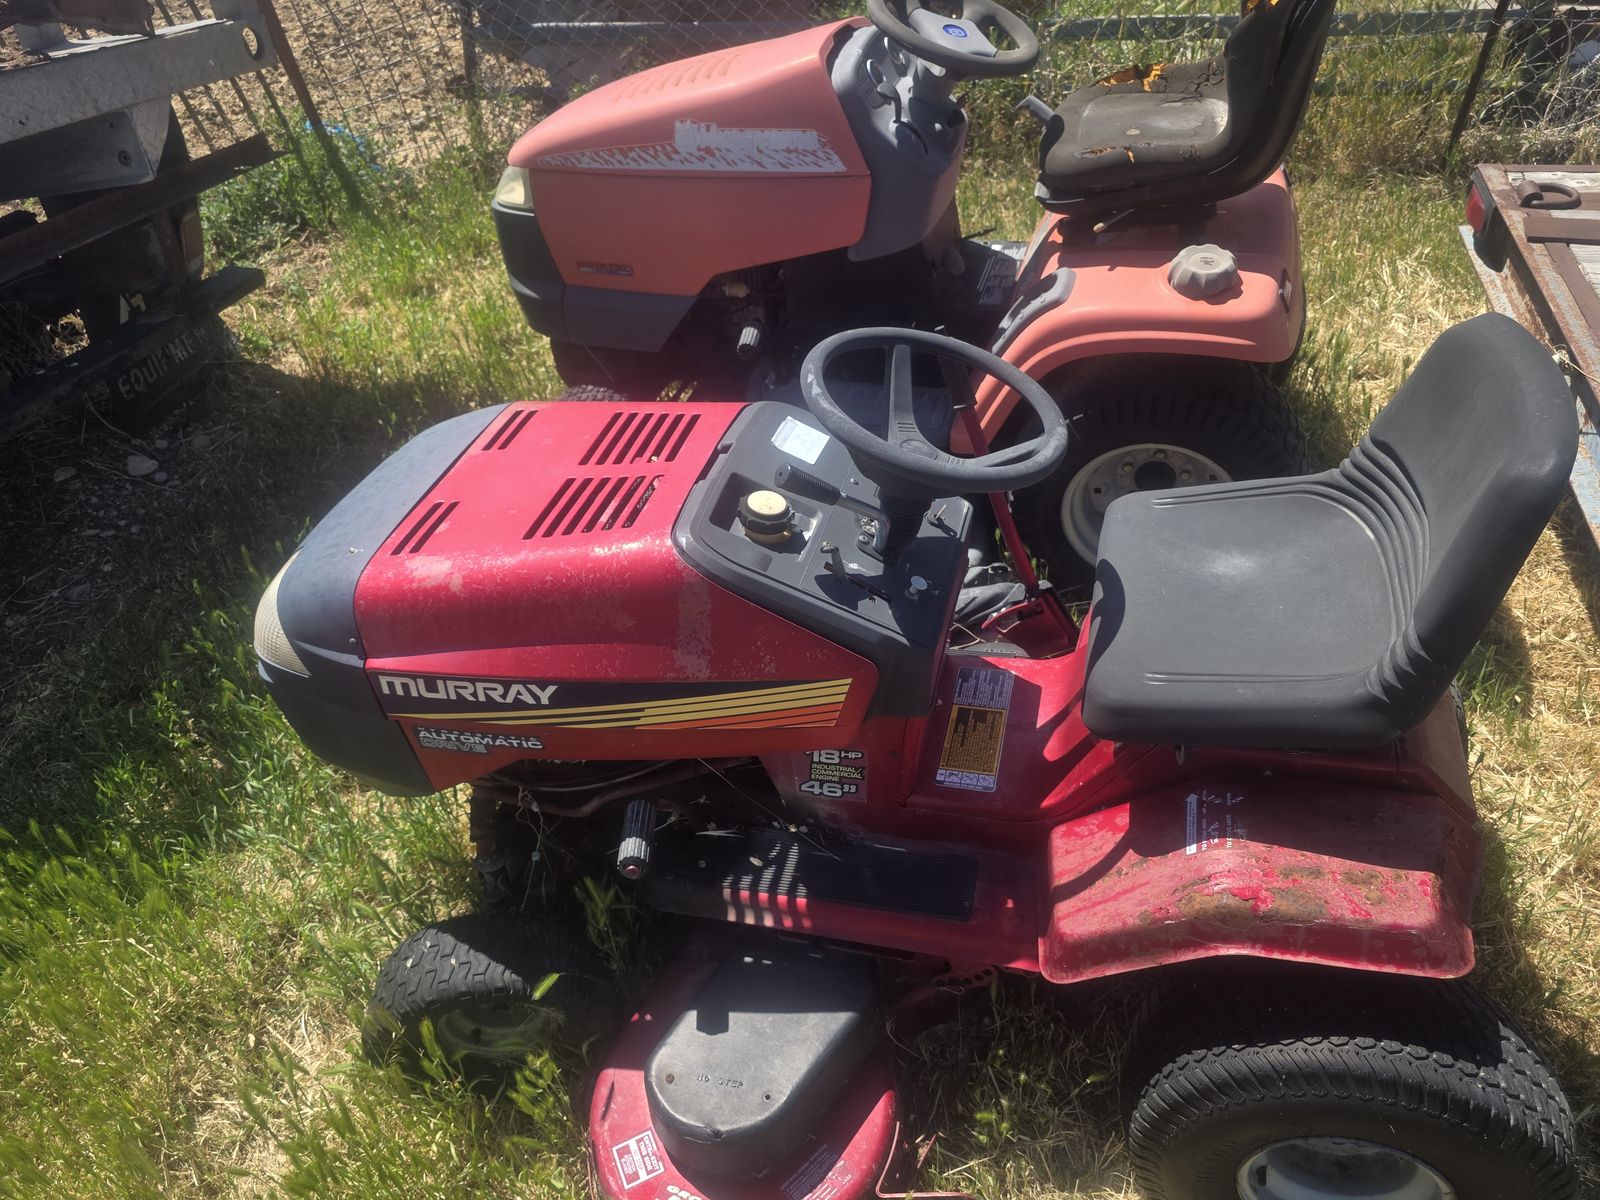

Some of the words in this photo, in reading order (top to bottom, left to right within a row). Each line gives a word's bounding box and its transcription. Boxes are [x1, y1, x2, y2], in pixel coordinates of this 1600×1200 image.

[377, 674, 559, 705] MURRAY
[418, 730, 543, 749] AUTOMATIC
[419, 737, 488, 754] DRIVE
[805, 750, 840, 763] 18
[811, 768, 863, 779] COMMERCIAL
[811, 774, 841, 782] ENGINE
[717, 1077, 744, 1090] STEP
